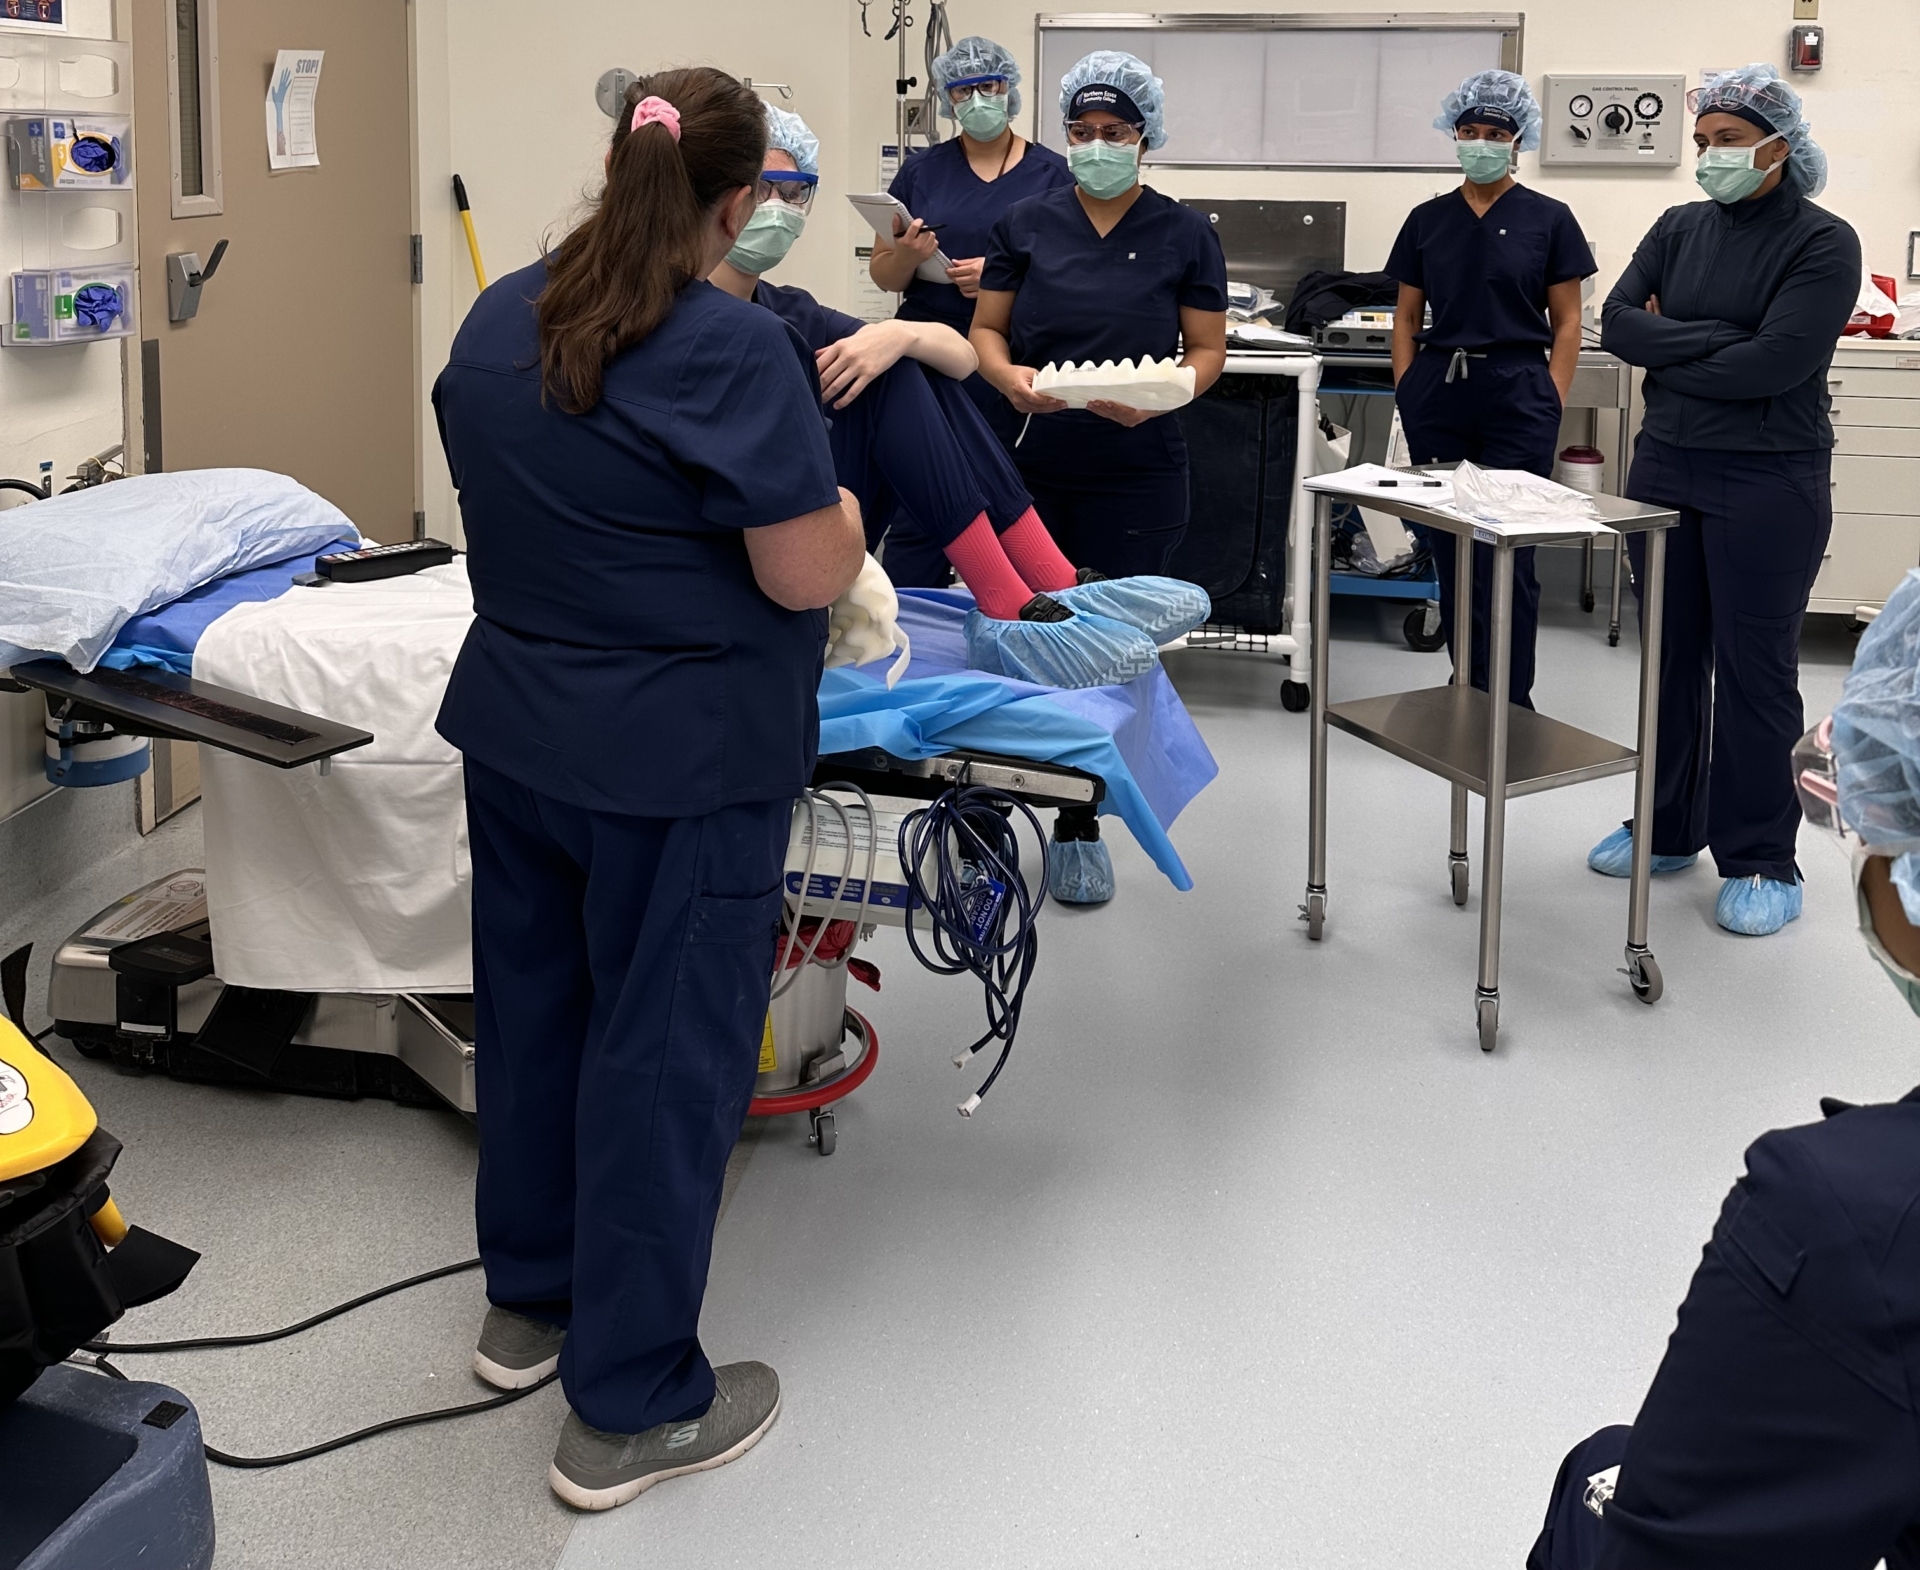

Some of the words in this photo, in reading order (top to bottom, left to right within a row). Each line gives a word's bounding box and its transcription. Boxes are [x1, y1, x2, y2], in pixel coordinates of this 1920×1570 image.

[295, 59, 319, 73] STOP!
[1083, 90, 1103, 98] Northern
[61, 297, 68, 312] L
[980, 898, 993, 911] DO
[975, 910, 988, 929] NOT
